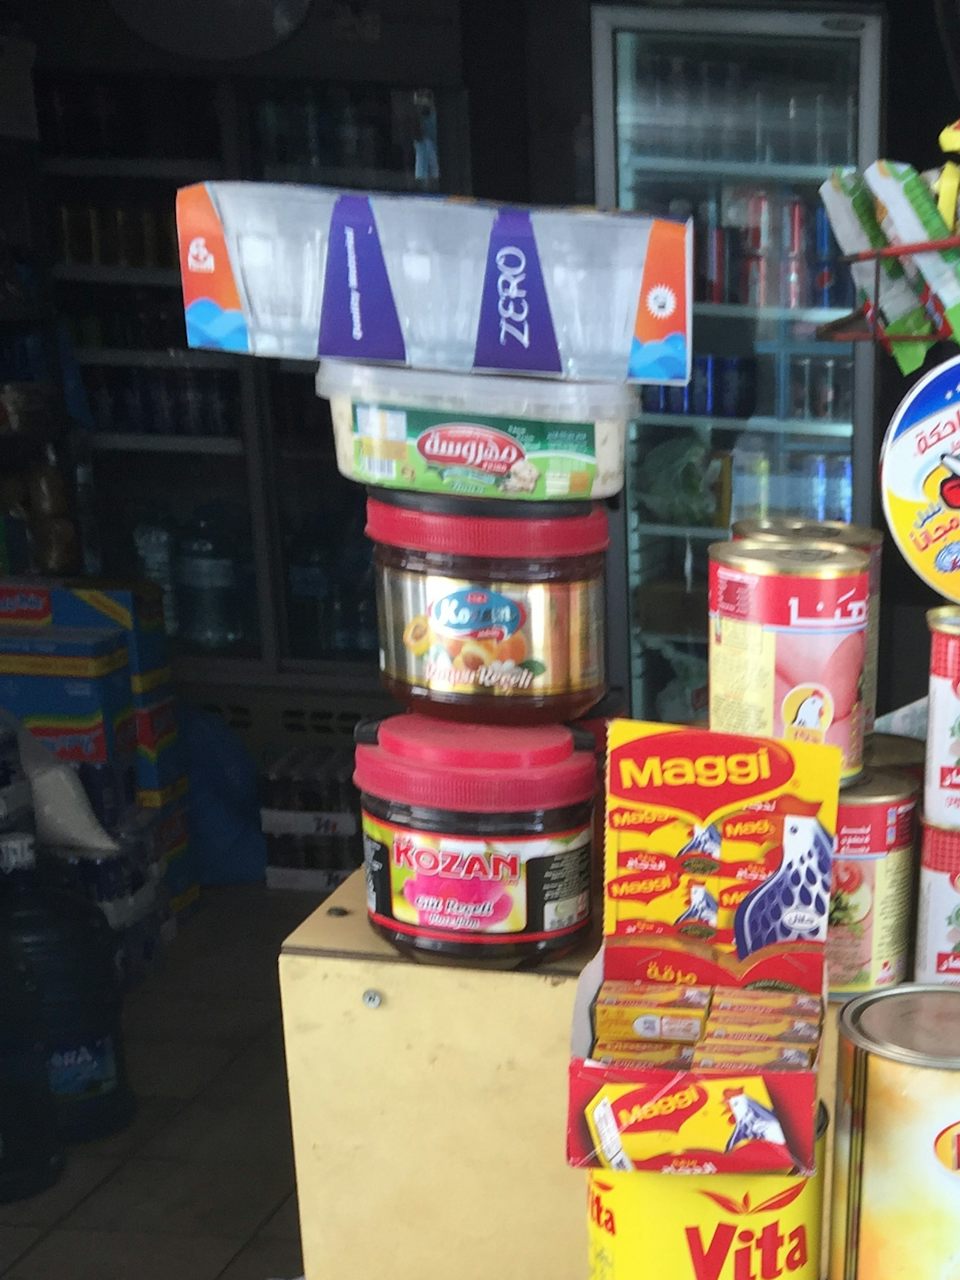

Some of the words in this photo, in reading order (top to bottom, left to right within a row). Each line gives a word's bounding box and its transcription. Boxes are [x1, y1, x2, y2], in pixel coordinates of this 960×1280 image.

[495, 246, 530, 350] ZERO
[619, 748, 772, 789] Maggi
[392, 842, 522, 881] KOZAN
[647, 962, 697, 986] مرقة
[618, 1086, 701, 1126] Maggi
